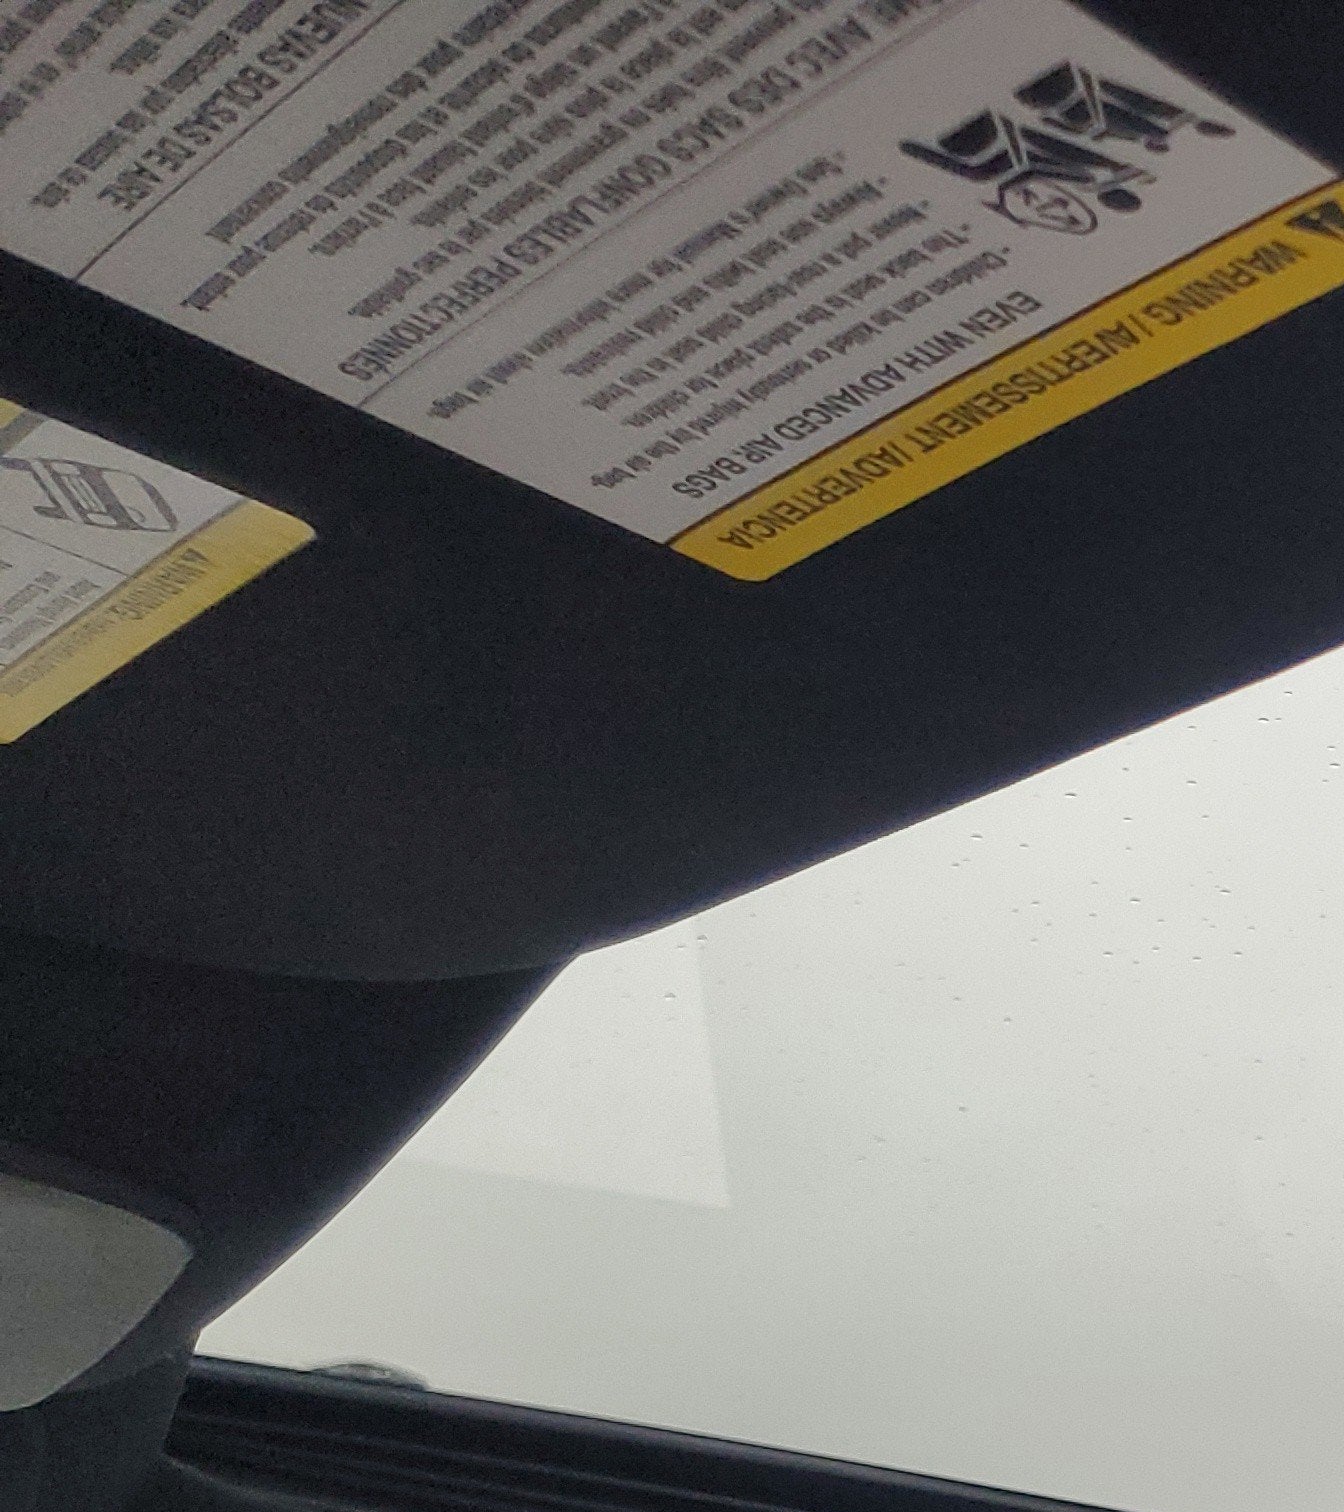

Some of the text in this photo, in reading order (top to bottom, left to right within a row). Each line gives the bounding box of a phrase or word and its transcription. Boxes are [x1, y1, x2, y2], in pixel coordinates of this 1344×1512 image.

[172, 64, 279, 144] BOLSAS
[97, 161, 162, 210] AIRE
[141, 136, 196, 172] DE
[1141, 240, 1305, 325] WARNING
[671, 291, 1042, 497] EVEN WITH ADVANCED AIR BAGS
